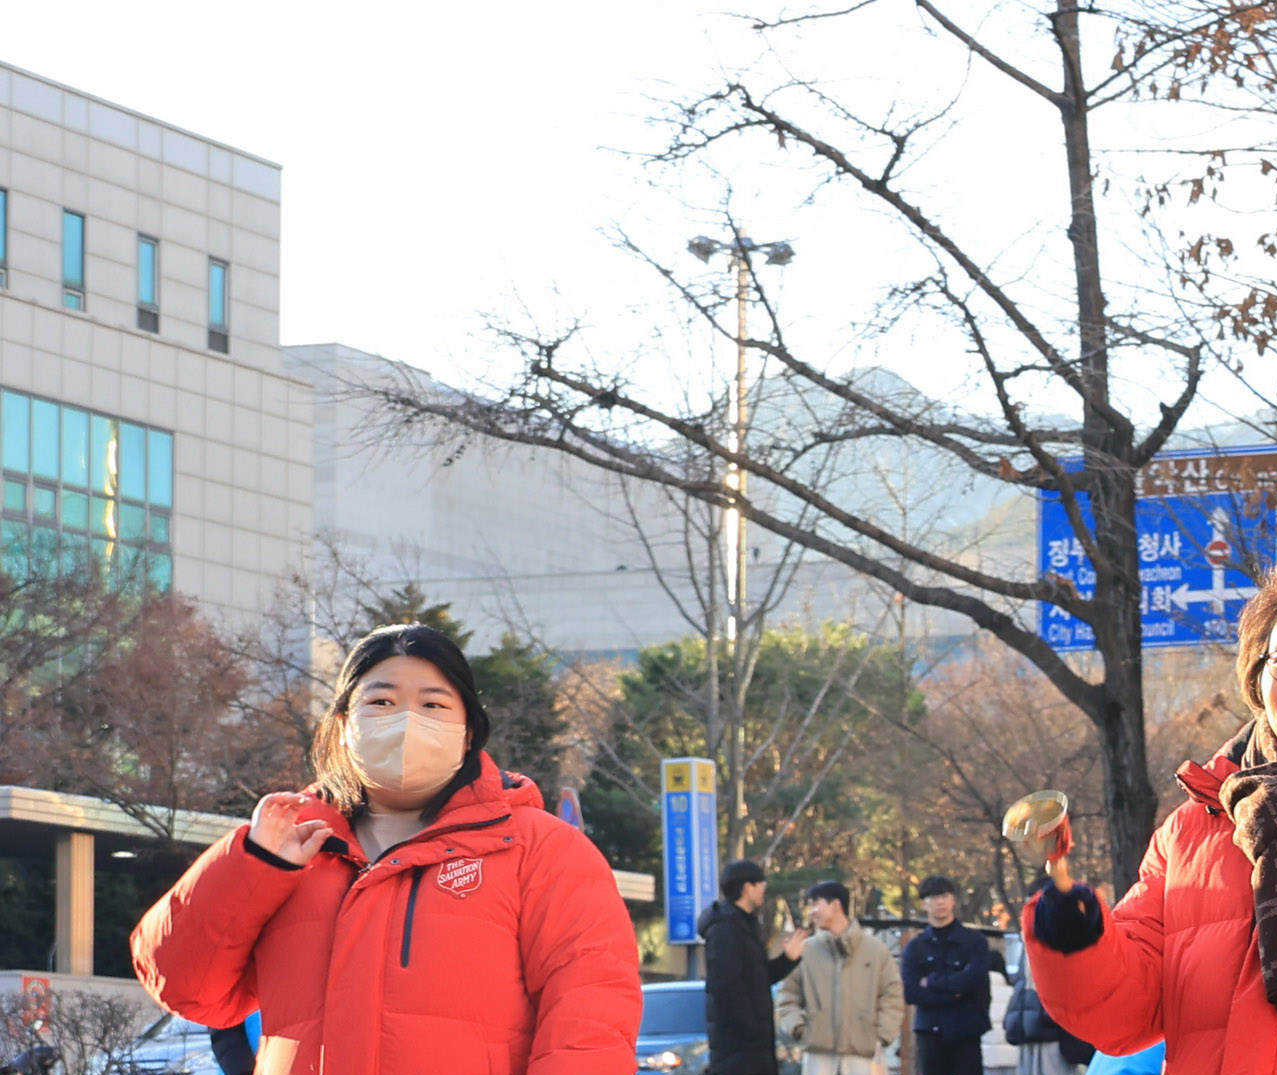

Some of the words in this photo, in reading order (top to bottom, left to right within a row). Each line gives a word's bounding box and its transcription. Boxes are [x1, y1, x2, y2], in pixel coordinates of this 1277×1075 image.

[440, 862, 480, 883] SALVATION
[447, 860, 466, 871] THE
[452, 872, 477, 888] ARMY
